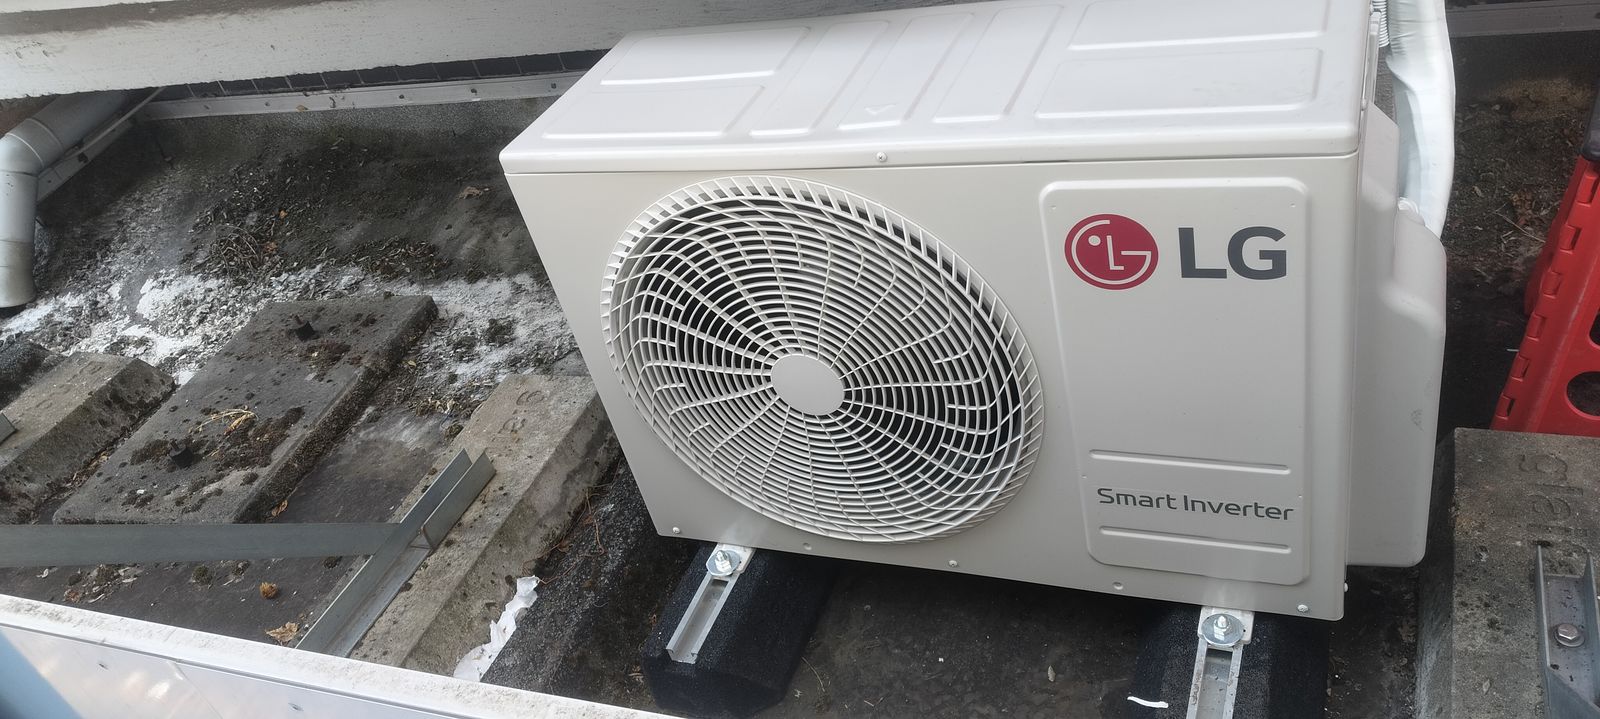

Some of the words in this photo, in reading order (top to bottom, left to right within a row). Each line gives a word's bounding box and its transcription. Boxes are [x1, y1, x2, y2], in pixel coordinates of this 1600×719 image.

[1178, 226, 1287, 280] LG
[1097, 487, 1178, 510] Smart
[1183, 494, 1295, 521] Inverter
